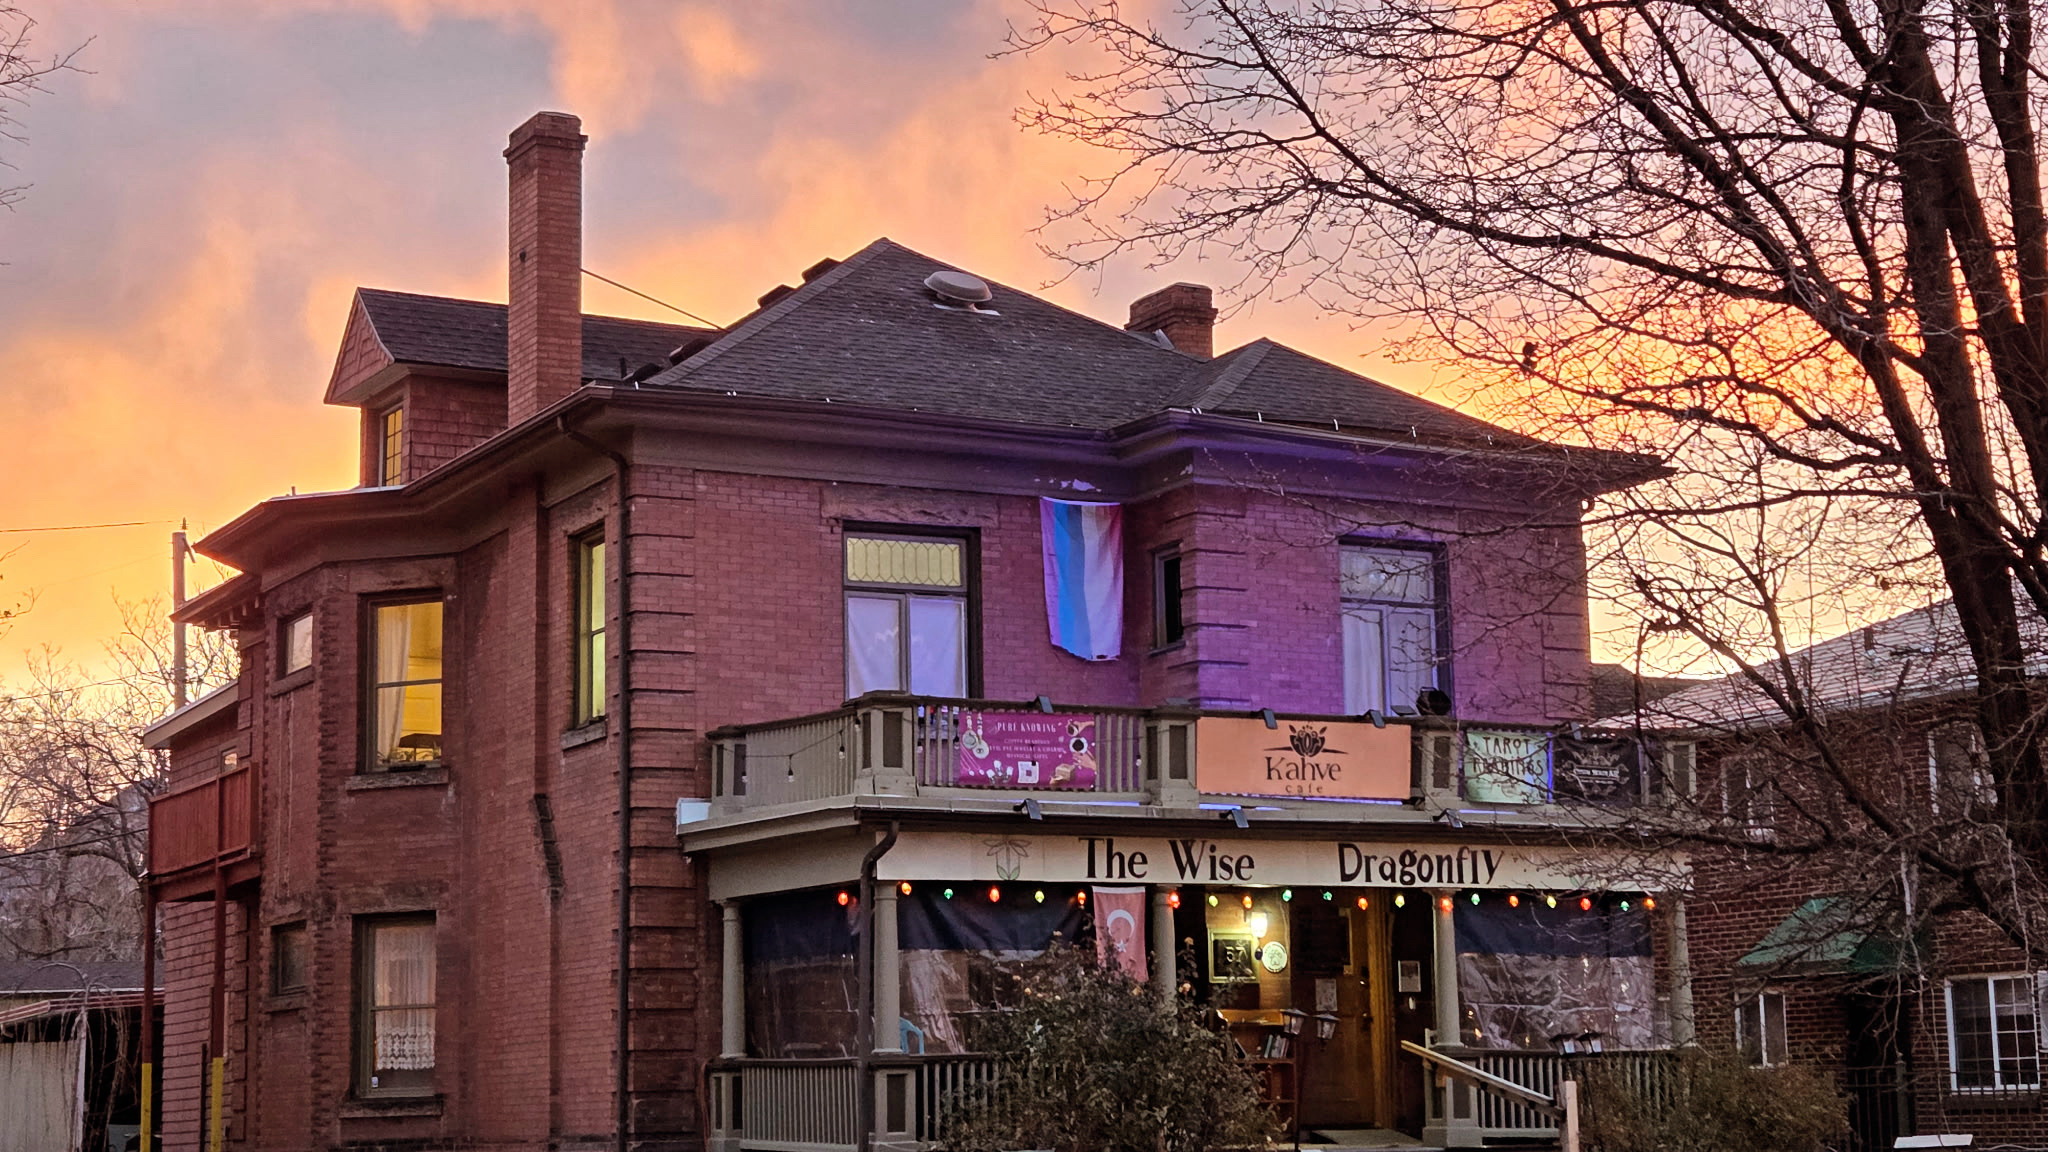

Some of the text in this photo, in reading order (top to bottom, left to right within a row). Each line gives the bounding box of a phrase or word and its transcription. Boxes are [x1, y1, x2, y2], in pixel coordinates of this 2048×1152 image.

[997, 722, 1057, 733] PURE KNOWING
[1483, 736, 1530, 755] TAROT
[1265, 757, 1341, 781] Kahve
[1285, 783, 1324, 794] cafe
[1078, 838, 1505, 885] The Wise Dragonfly
